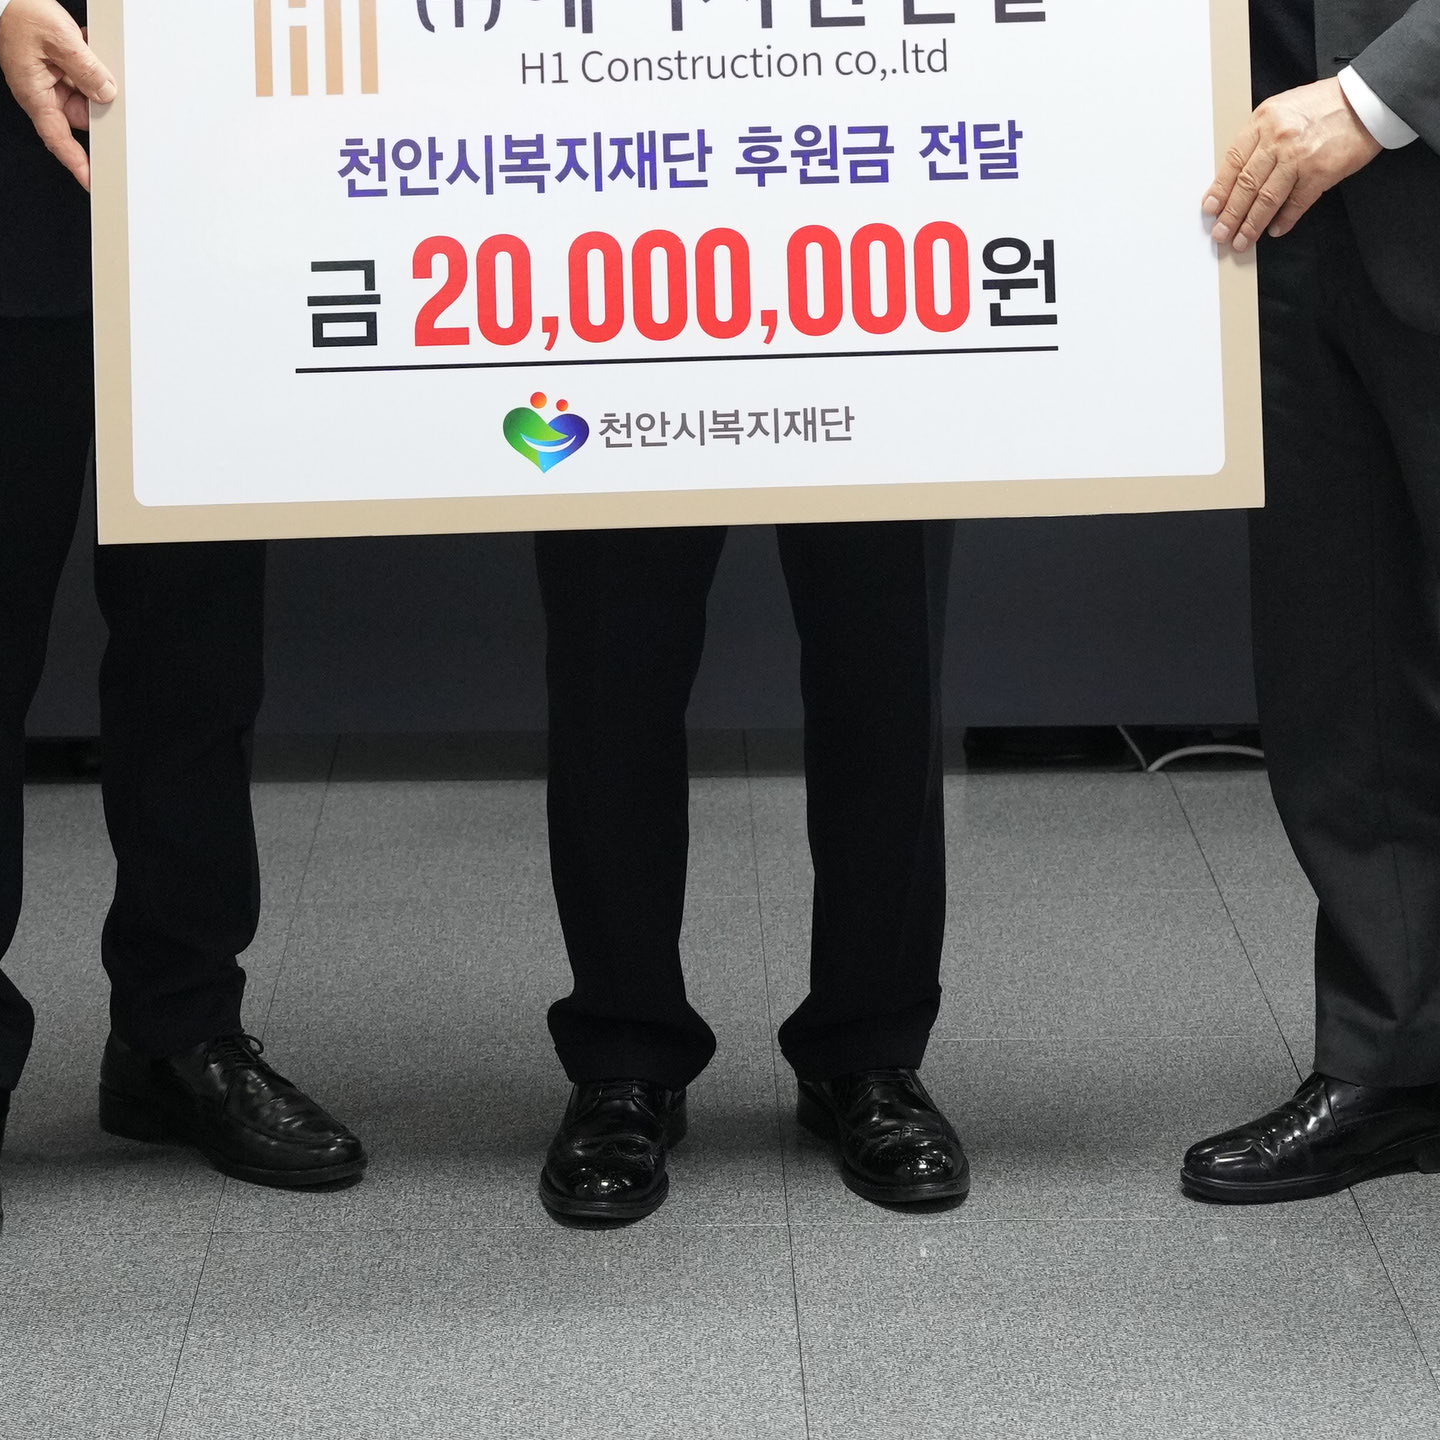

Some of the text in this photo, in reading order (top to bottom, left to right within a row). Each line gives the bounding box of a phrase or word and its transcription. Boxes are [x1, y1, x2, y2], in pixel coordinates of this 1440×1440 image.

[521, 37, 948, 85] H1 Construction co,.ltd
[337, 119, 1024, 198] 천안시복지재단 후원금 전달
[306, 220, 1059, 352] 금 20,000,000원
[598, 405, 855, 449] 천안시복지재단
